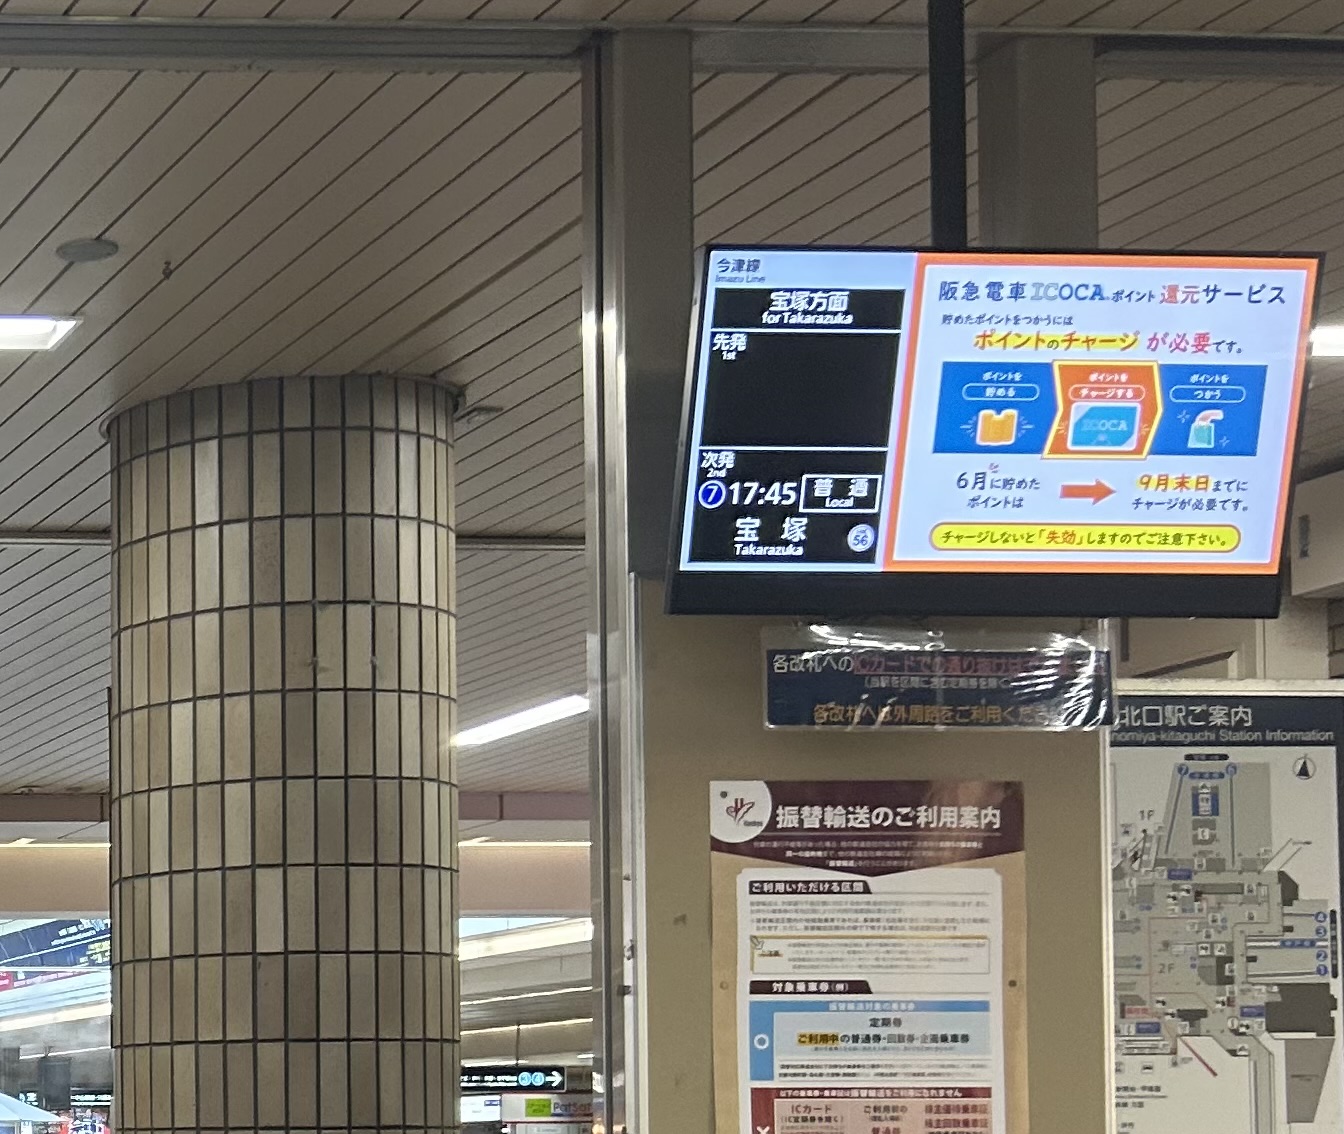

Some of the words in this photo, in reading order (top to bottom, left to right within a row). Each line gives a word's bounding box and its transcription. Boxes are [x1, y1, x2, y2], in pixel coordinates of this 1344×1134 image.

[716, 258, 761, 273] 今津線
[769, 290, 850, 311] 宝塚方面
[762, 312, 781, 324] for
[783, 311, 853, 324] Takarazuka
[941, 314, 1074, 326] 貯めたポイントをつかうには
[712, 333, 747, 351] 先発
[722, 351, 736, 360] 1st
[983, 371, 1022, 382] ポイントを
[1089, 372, 1128, 383] ポイントを
[1190, 373, 1229, 383] ポイントを
[1079, 388, 1133, 398] チャージする
[1193, 389, 1221, 399] つかう
[1082, 419, 1127, 431] ICOCA
[701, 451, 736, 468] 次発
[707, 468, 727, 478] 2nd
[814, 479, 869, 497] 普通
[1139, 473, 1248, 492] 9月末日までに
[729, 481, 797, 505] 17:45
[825, 497, 854, 507] Local
[967, 497, 1024, 508] ポイントは
[1132, 498, 1248, 512] チャージが必要です。
[734, 516, 808, 542] 宝塚
[853, 534, 868, 545] 56
[734, 544, 804, 555] Takarazuka
[1219, 730, 1262, 741] Station
[1266, 730, 1334, 741] Information
[776, 805, 1001, 830] 振替輸送のご利用案内
[752, 881, 864, 893] ご利用いただける区間
[1159, 963, 1175, 973] 2F
[869, 1018, 902, 1028] 定期券
[791, 1104, 832, 1114] ICカード
